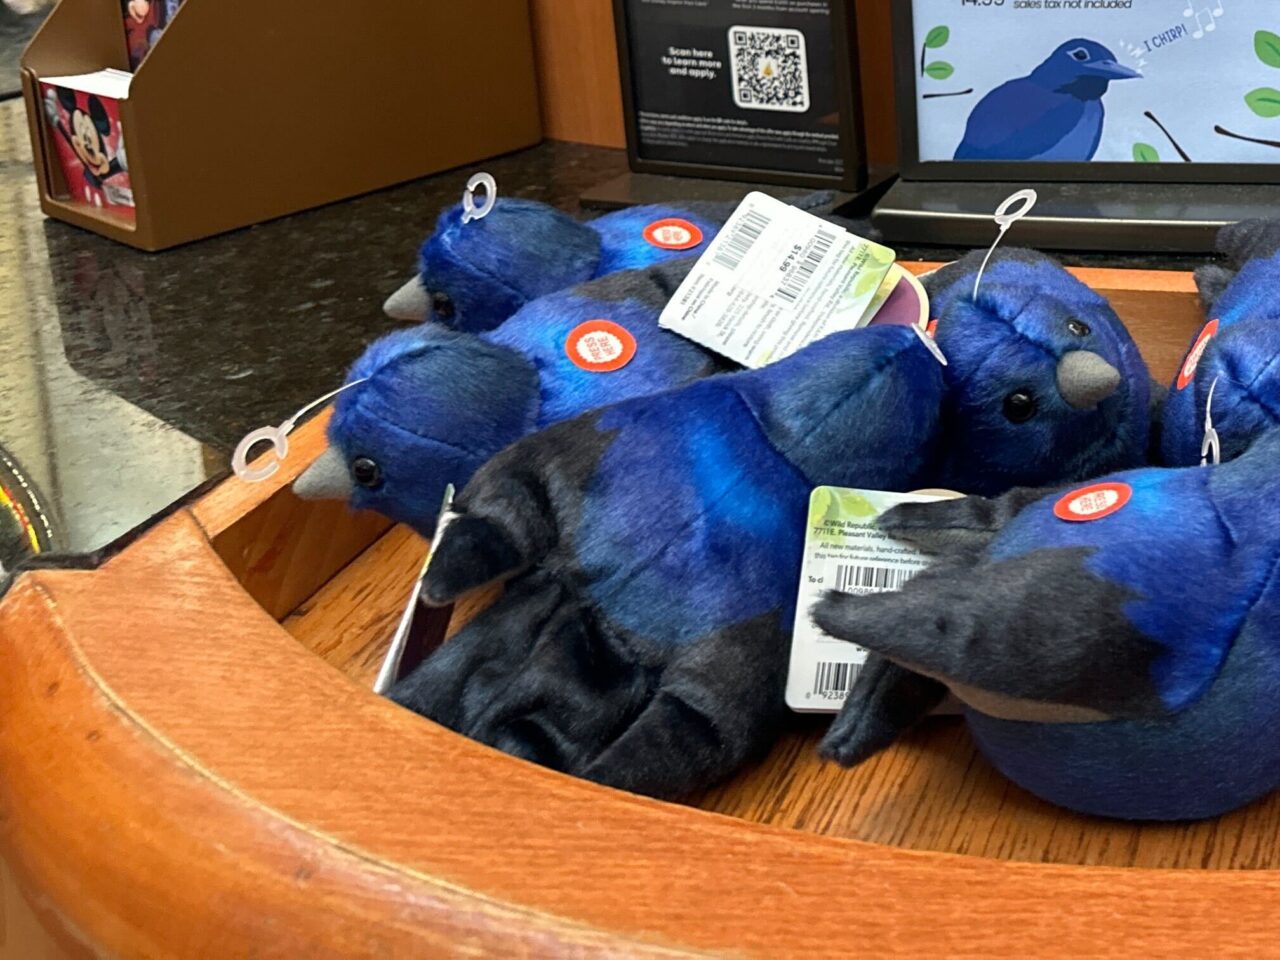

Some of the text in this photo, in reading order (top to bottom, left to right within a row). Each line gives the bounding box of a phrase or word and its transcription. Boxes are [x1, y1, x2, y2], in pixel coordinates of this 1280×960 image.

[1044, 0, 1062, 9] tax
[1063, 0, 1083, 9] not
[1143, 23, 1189, 52] I CHIRP!
[669, 46, 713, 58] Scan here
[661, 56, 722, 68] to learn more
[669, 67, 716, 80] and apply.
[779, 244, 802, 272] $14.99
